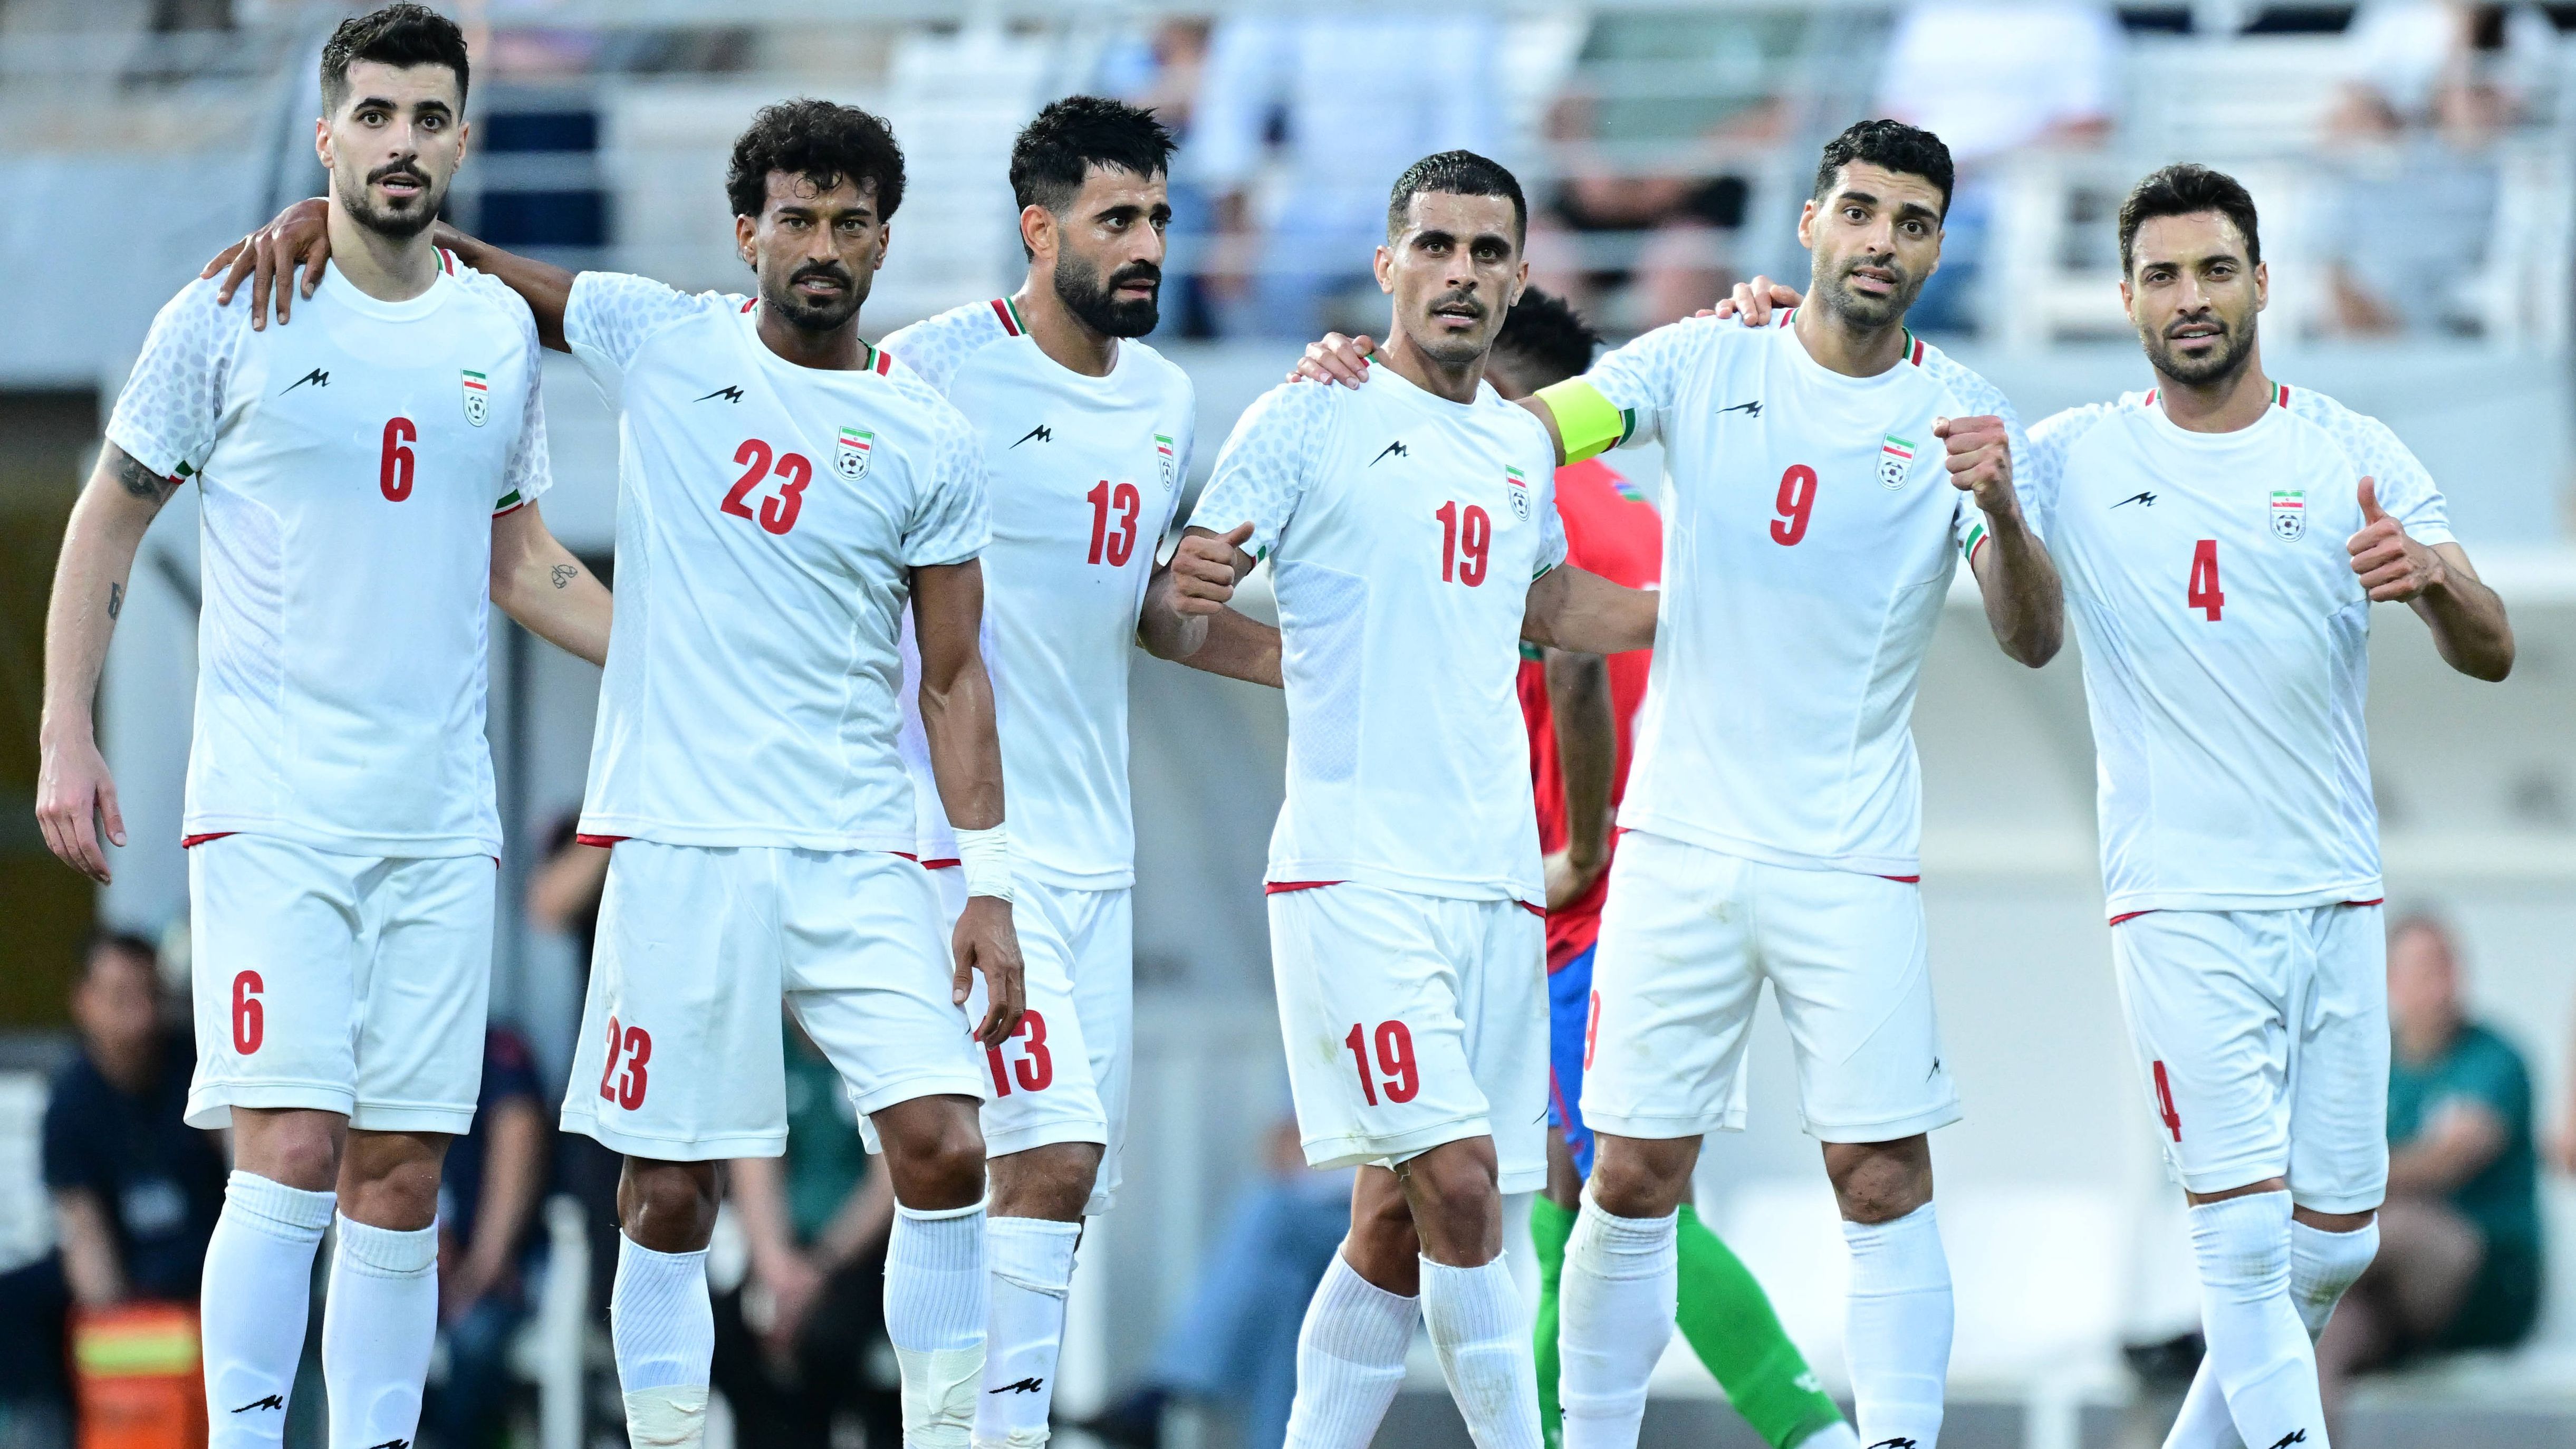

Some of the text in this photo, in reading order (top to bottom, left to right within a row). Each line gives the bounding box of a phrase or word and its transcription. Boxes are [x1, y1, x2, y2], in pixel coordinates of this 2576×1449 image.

[381, 417, 416, 502] 6
[721, 438, 812, 535] 23
[1088, 481, 1140, 567] 13
[1436, 501, 1491, 587] 19
[1771, 464, 1817, 546] 9
[2188, 540, 2224, 621] 4
[233, 970, 264, 1055] 6
[601, 1016, 651, 1110] 23
[1345, 1020, 1419, 1106] 19
[2154, 1061, 2181, 1142] 4
